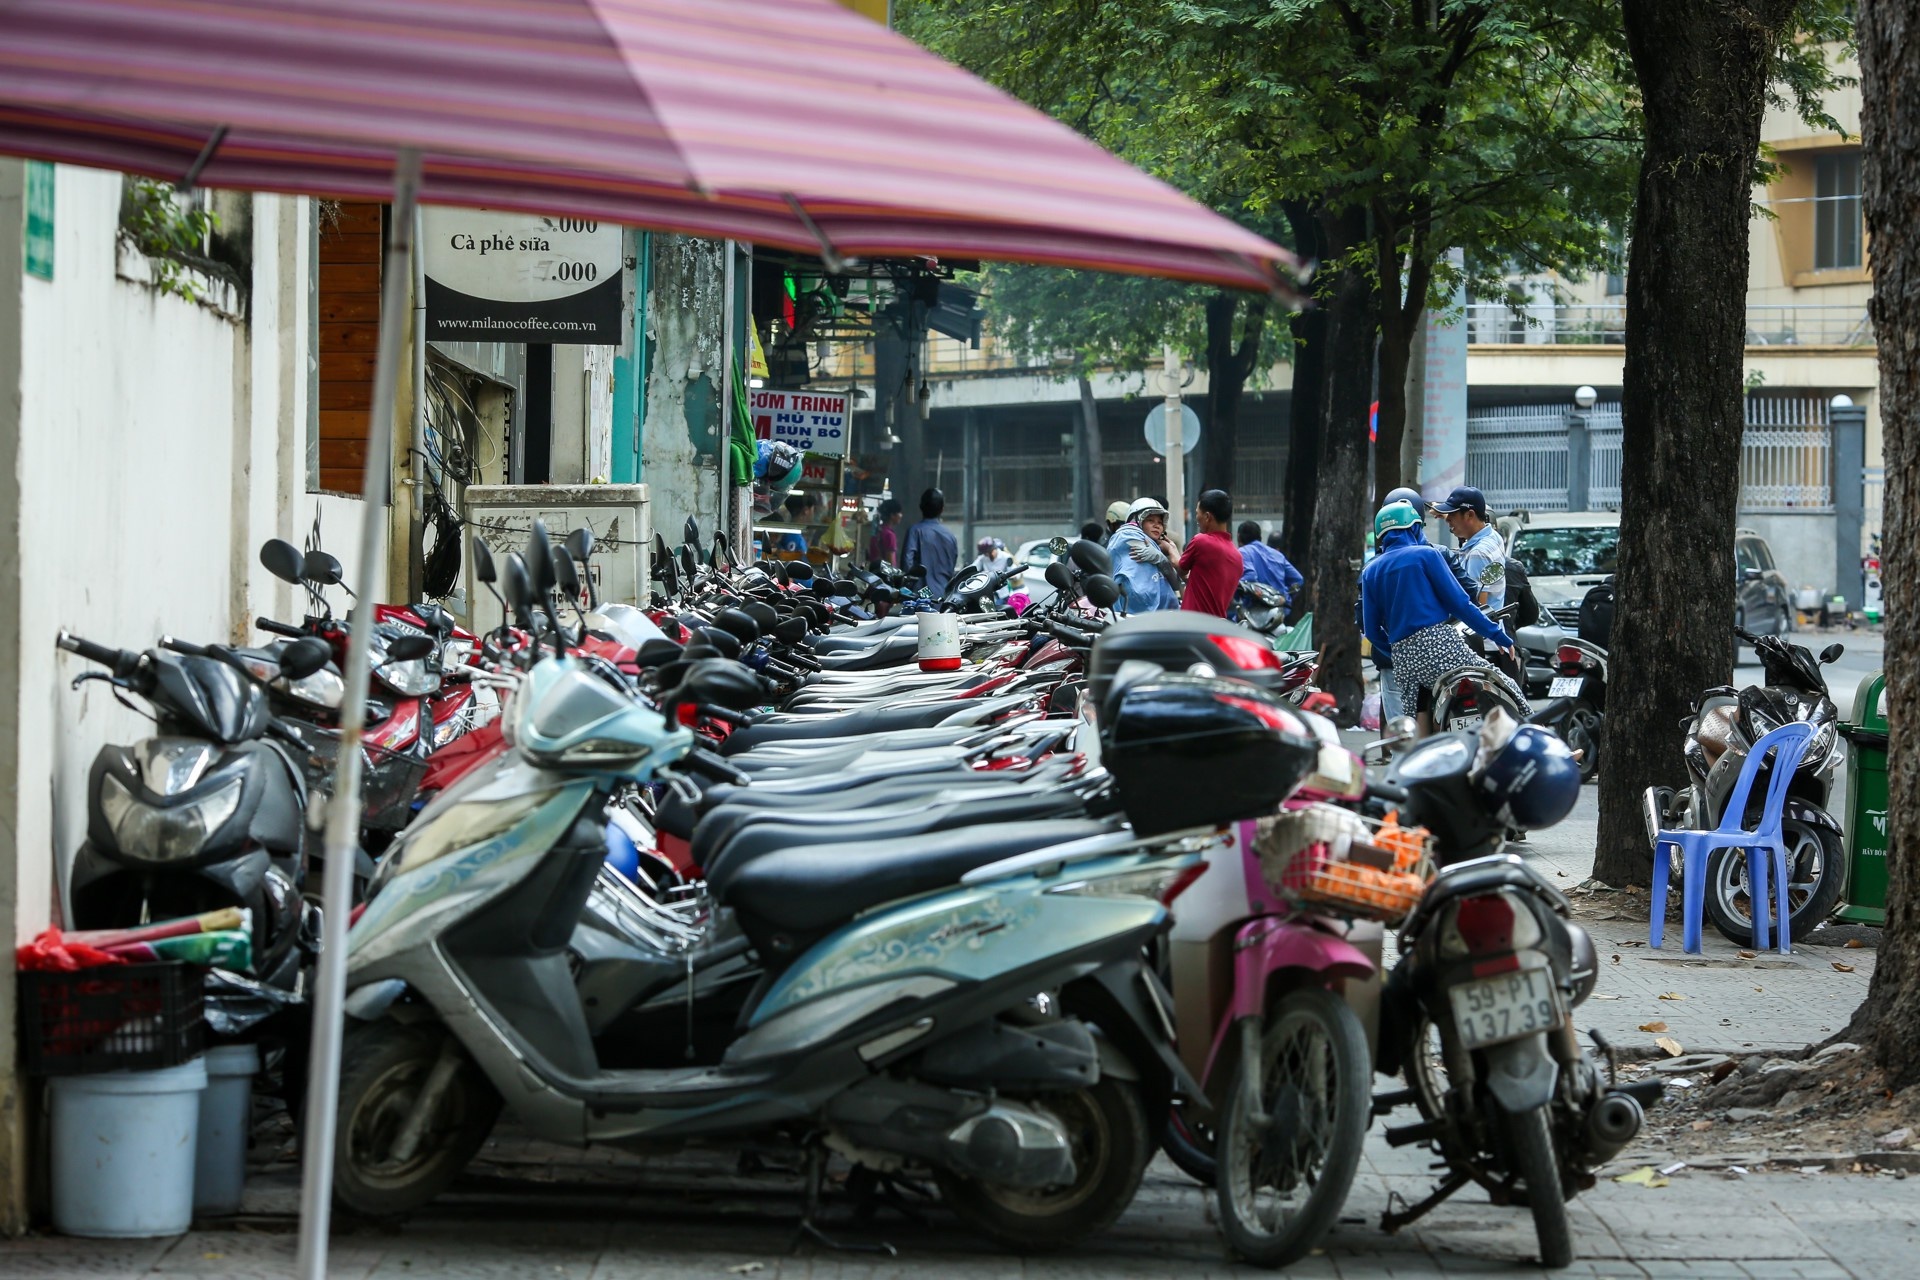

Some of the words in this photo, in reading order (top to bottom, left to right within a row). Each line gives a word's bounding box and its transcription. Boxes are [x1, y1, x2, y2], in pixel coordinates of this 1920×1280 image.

[451, 234, 475, 250] Cà
[479, 234, 515, 256] phê
[438, 317, 597, 331] www.milanocoffee.com.vn
[791, 395, 845, 413] TRINH
